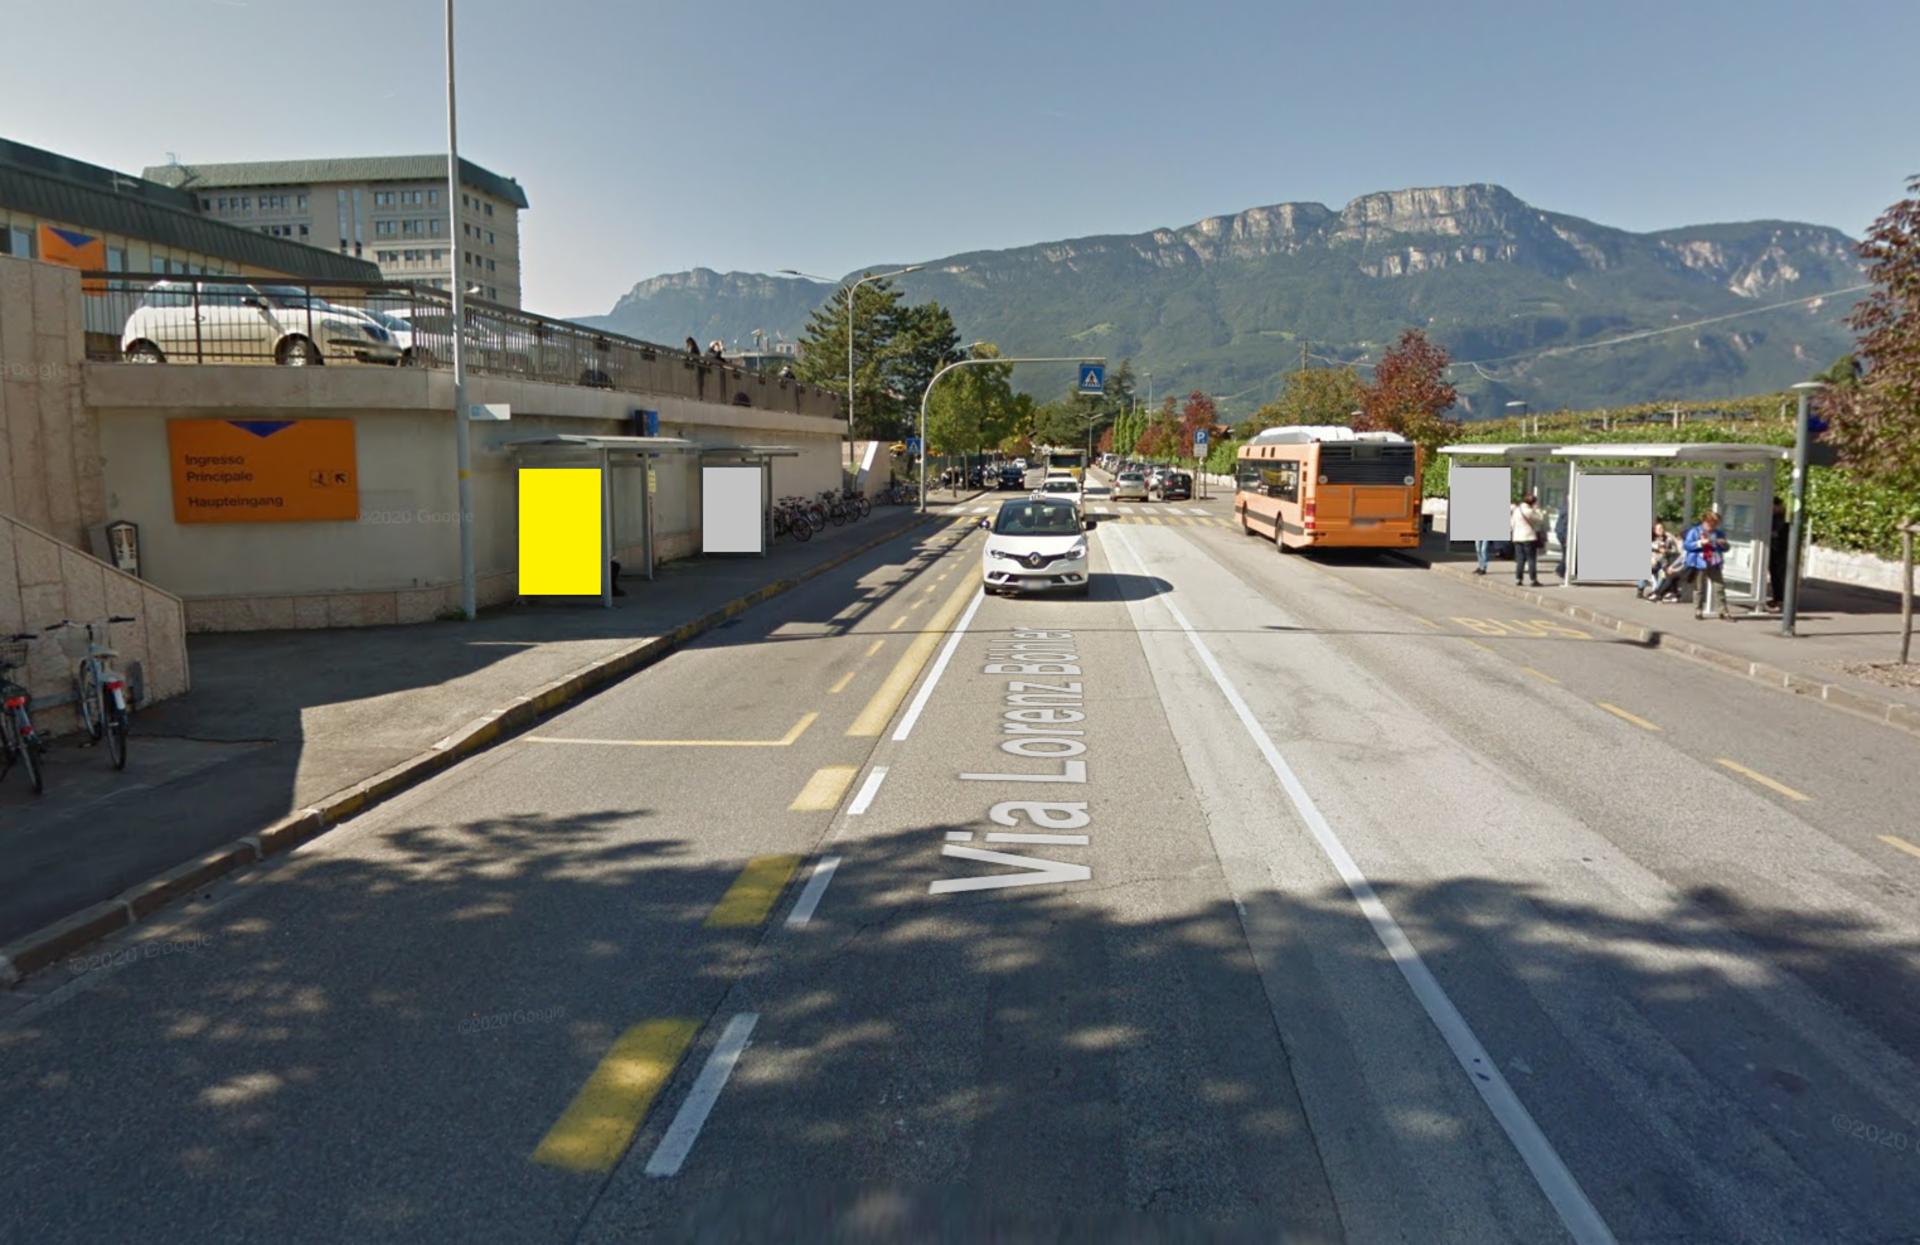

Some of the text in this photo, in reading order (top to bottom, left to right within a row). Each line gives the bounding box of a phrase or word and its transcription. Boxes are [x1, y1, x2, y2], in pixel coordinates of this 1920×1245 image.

[1197, 432, 1205, 443] P
[185, 454, 245, 467] Ingresso
[186, 471, 254, 483] Principale
[188, 496, 284, 509] Haupteingang
[1450, 616, 1594, 640] BUS
